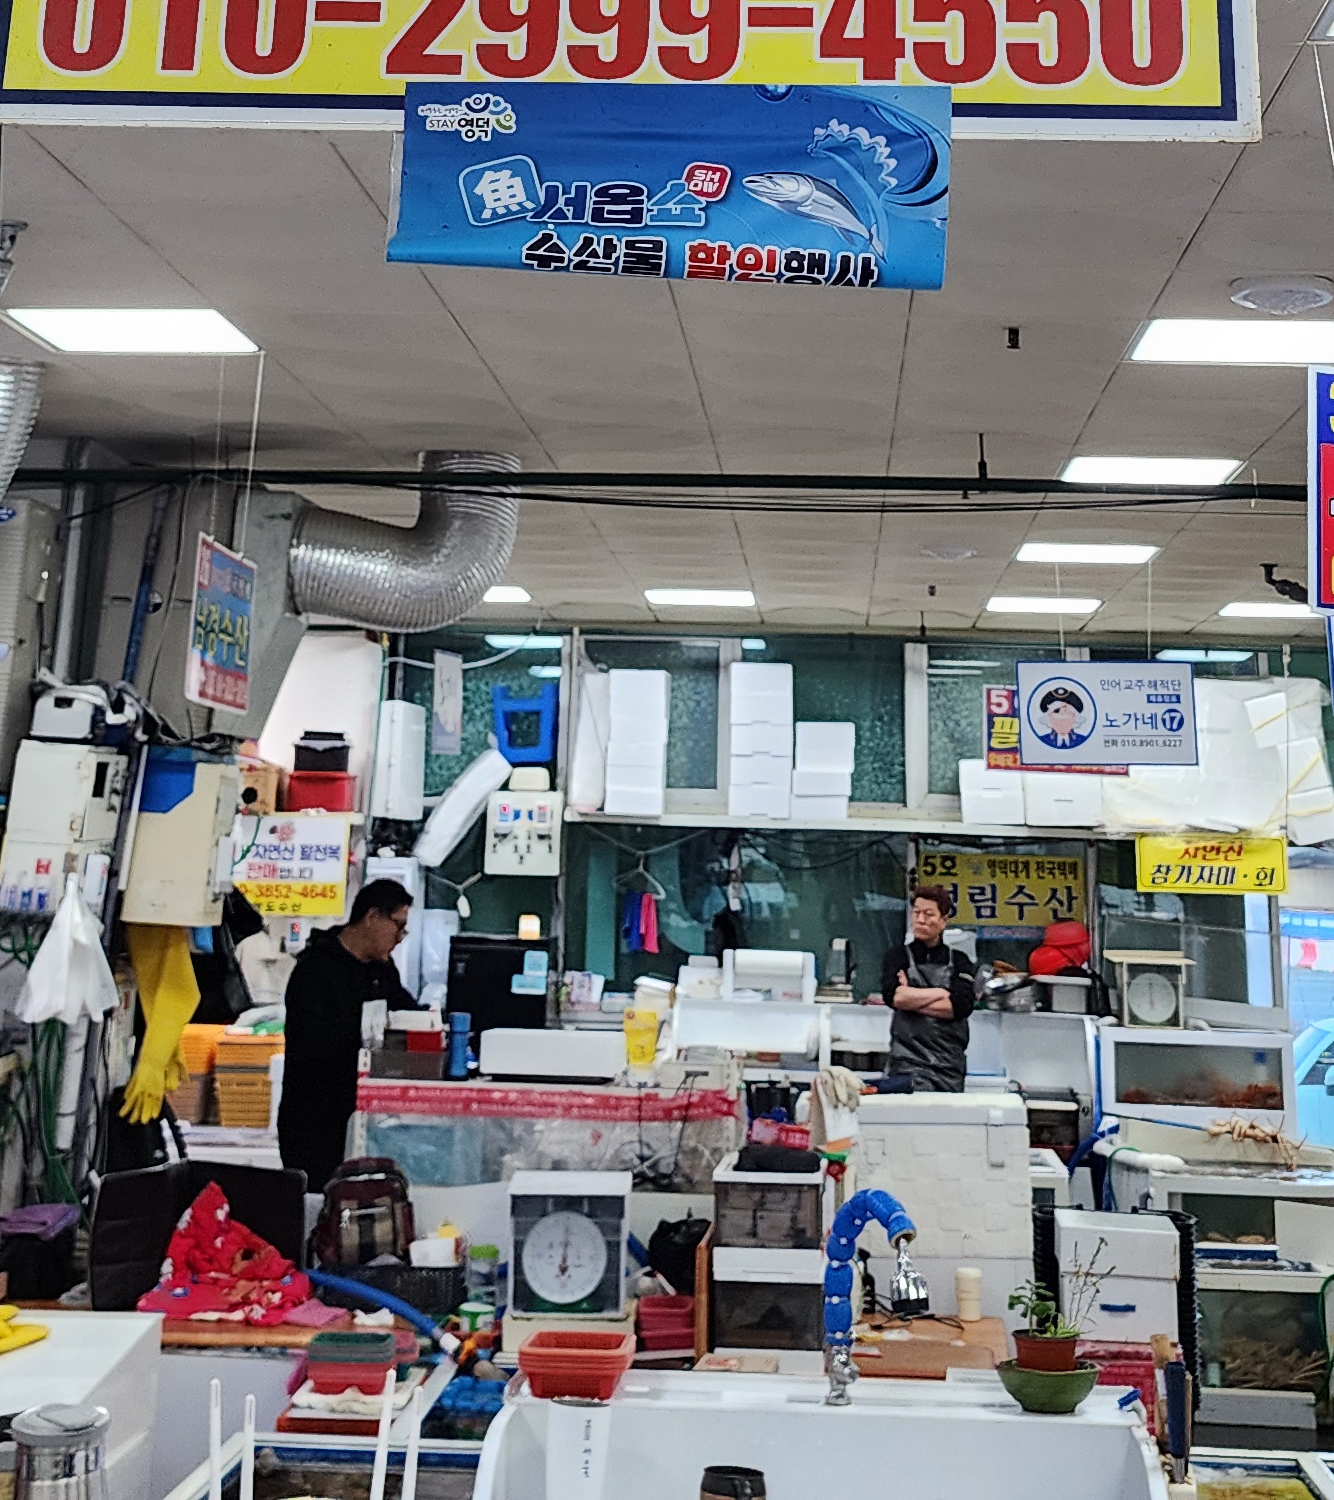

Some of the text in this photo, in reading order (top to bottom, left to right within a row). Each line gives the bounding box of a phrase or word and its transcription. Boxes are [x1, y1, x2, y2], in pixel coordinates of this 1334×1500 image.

[428, 116, 491, 140] STAY 영덕
[521, 232, 666, 278] 수산물
[196, 598, 249, 667] 남경수산
[1102, 712, 1182, 731] 노가네 17
[922, 855, 958, 877] 5호
[1150, 863, 1275, 886] 참가자미 회
